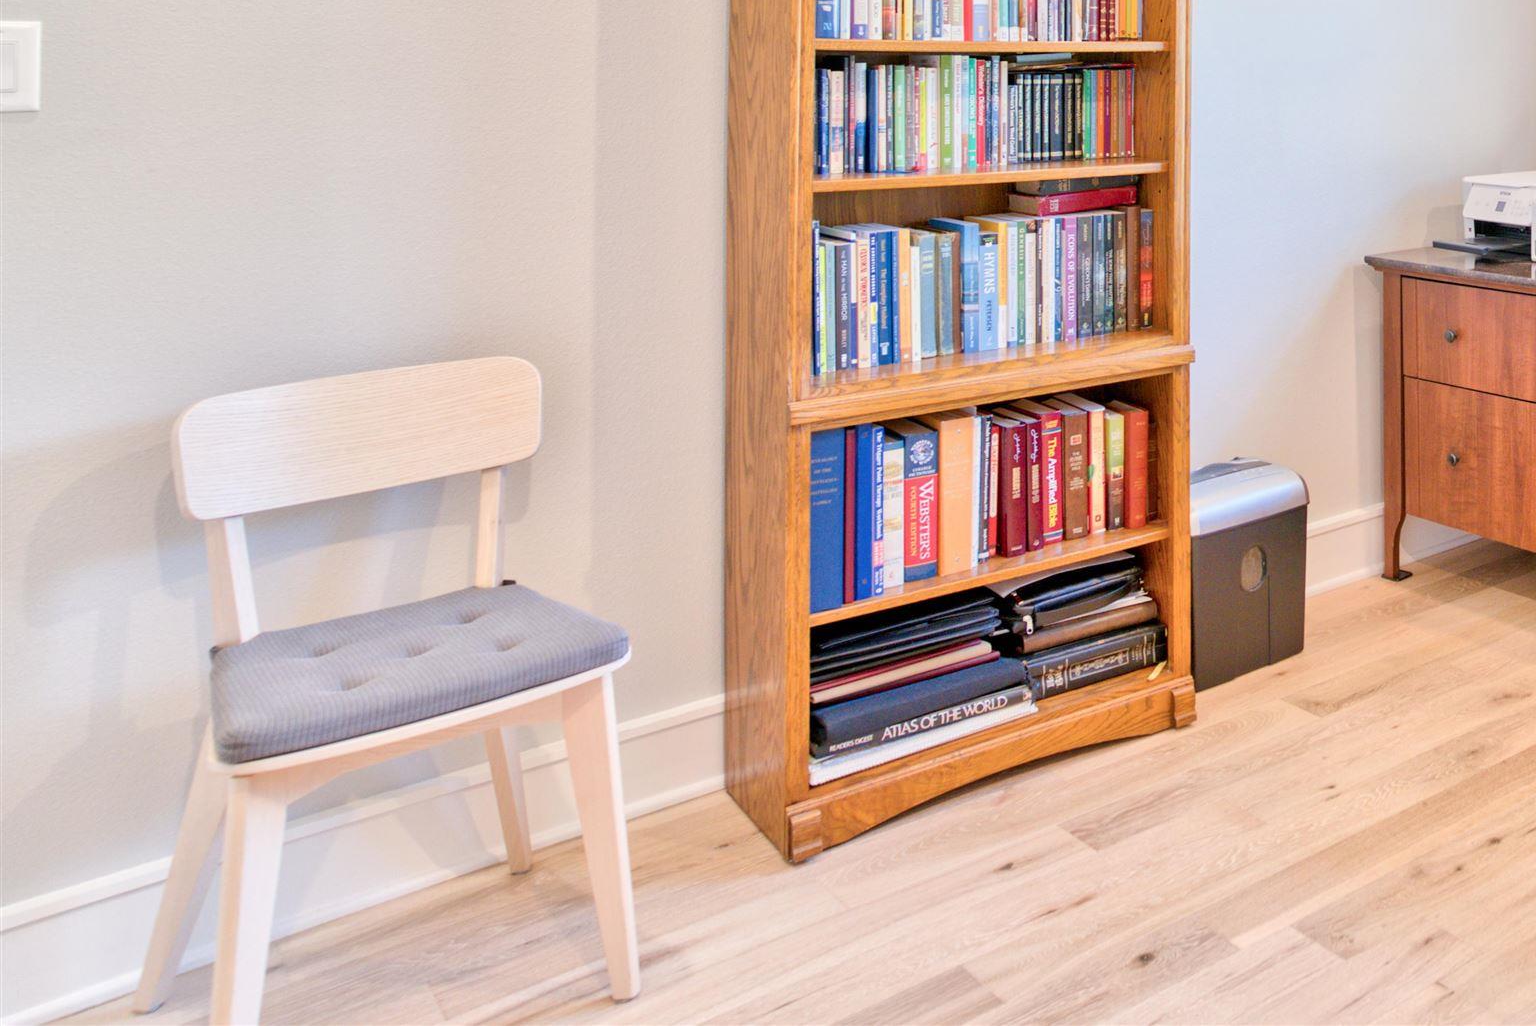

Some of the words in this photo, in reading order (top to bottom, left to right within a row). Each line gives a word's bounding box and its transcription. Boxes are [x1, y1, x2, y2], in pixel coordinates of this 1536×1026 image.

[977, 96, 985, 127] Dictionary
[1067, 234, 1075, 259] ICONS
[983, 252, 996, 294] HYMNS
[1067, 263, 1075, 272] OF
[1067, 275, 1075, 321] EVOLUTION
[1047, 437, 1057, 458] The
[1046, 458, 1058, 504] Amplified
[910, 485, 918, 520] FOURTH
[919, 477, 934, 560] WEBSTER'S
[1048, 504, 1058, 528] Bible
[910, 522, 918, 557] EDITION
[881, 719, 919, 741] ATLAS
[920, 714, 942, 730] OF
[939, 707, 963, 725] THE
[963, 695, 1008, 716] WORLD
